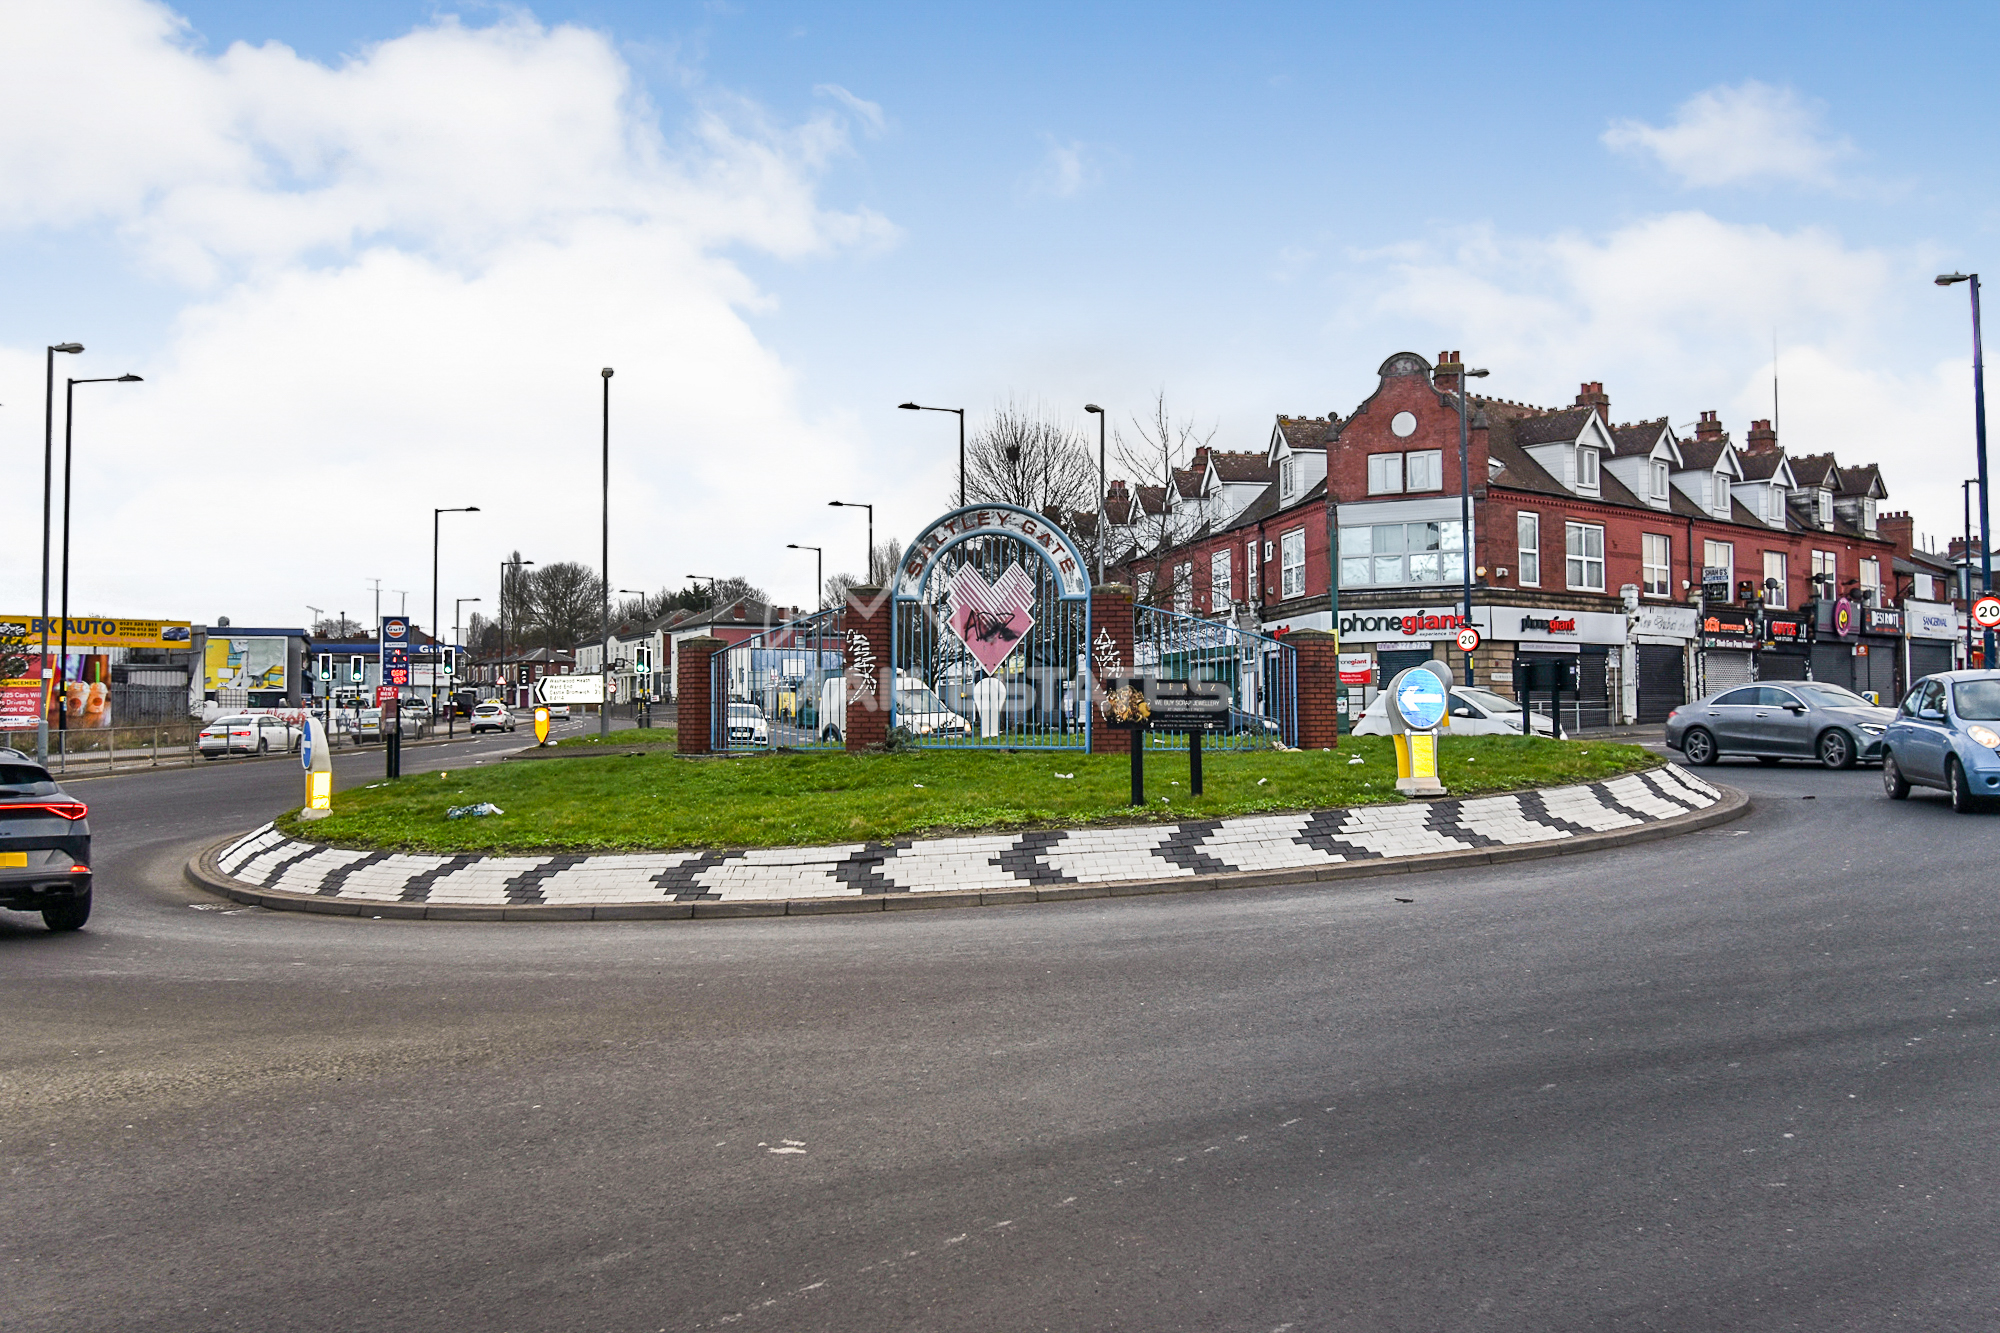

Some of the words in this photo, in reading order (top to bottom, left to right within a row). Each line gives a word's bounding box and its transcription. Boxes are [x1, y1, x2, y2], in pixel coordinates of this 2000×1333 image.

[908, 512, 1010, 577] SALTLEY
[1022, 519, 1076, 574] GATE
[1978, 605, 2000, 617] 20
[31, 618, 57, 634] BK
[65, 619, 116, 636] AUTO
[1340, 610, 1466, 637] phonegiant
[1461, 635, 1475, 644] 20
[419, 645, 450, 653] Gul
[1192, 699, 1220, 707] JEWELLERY
